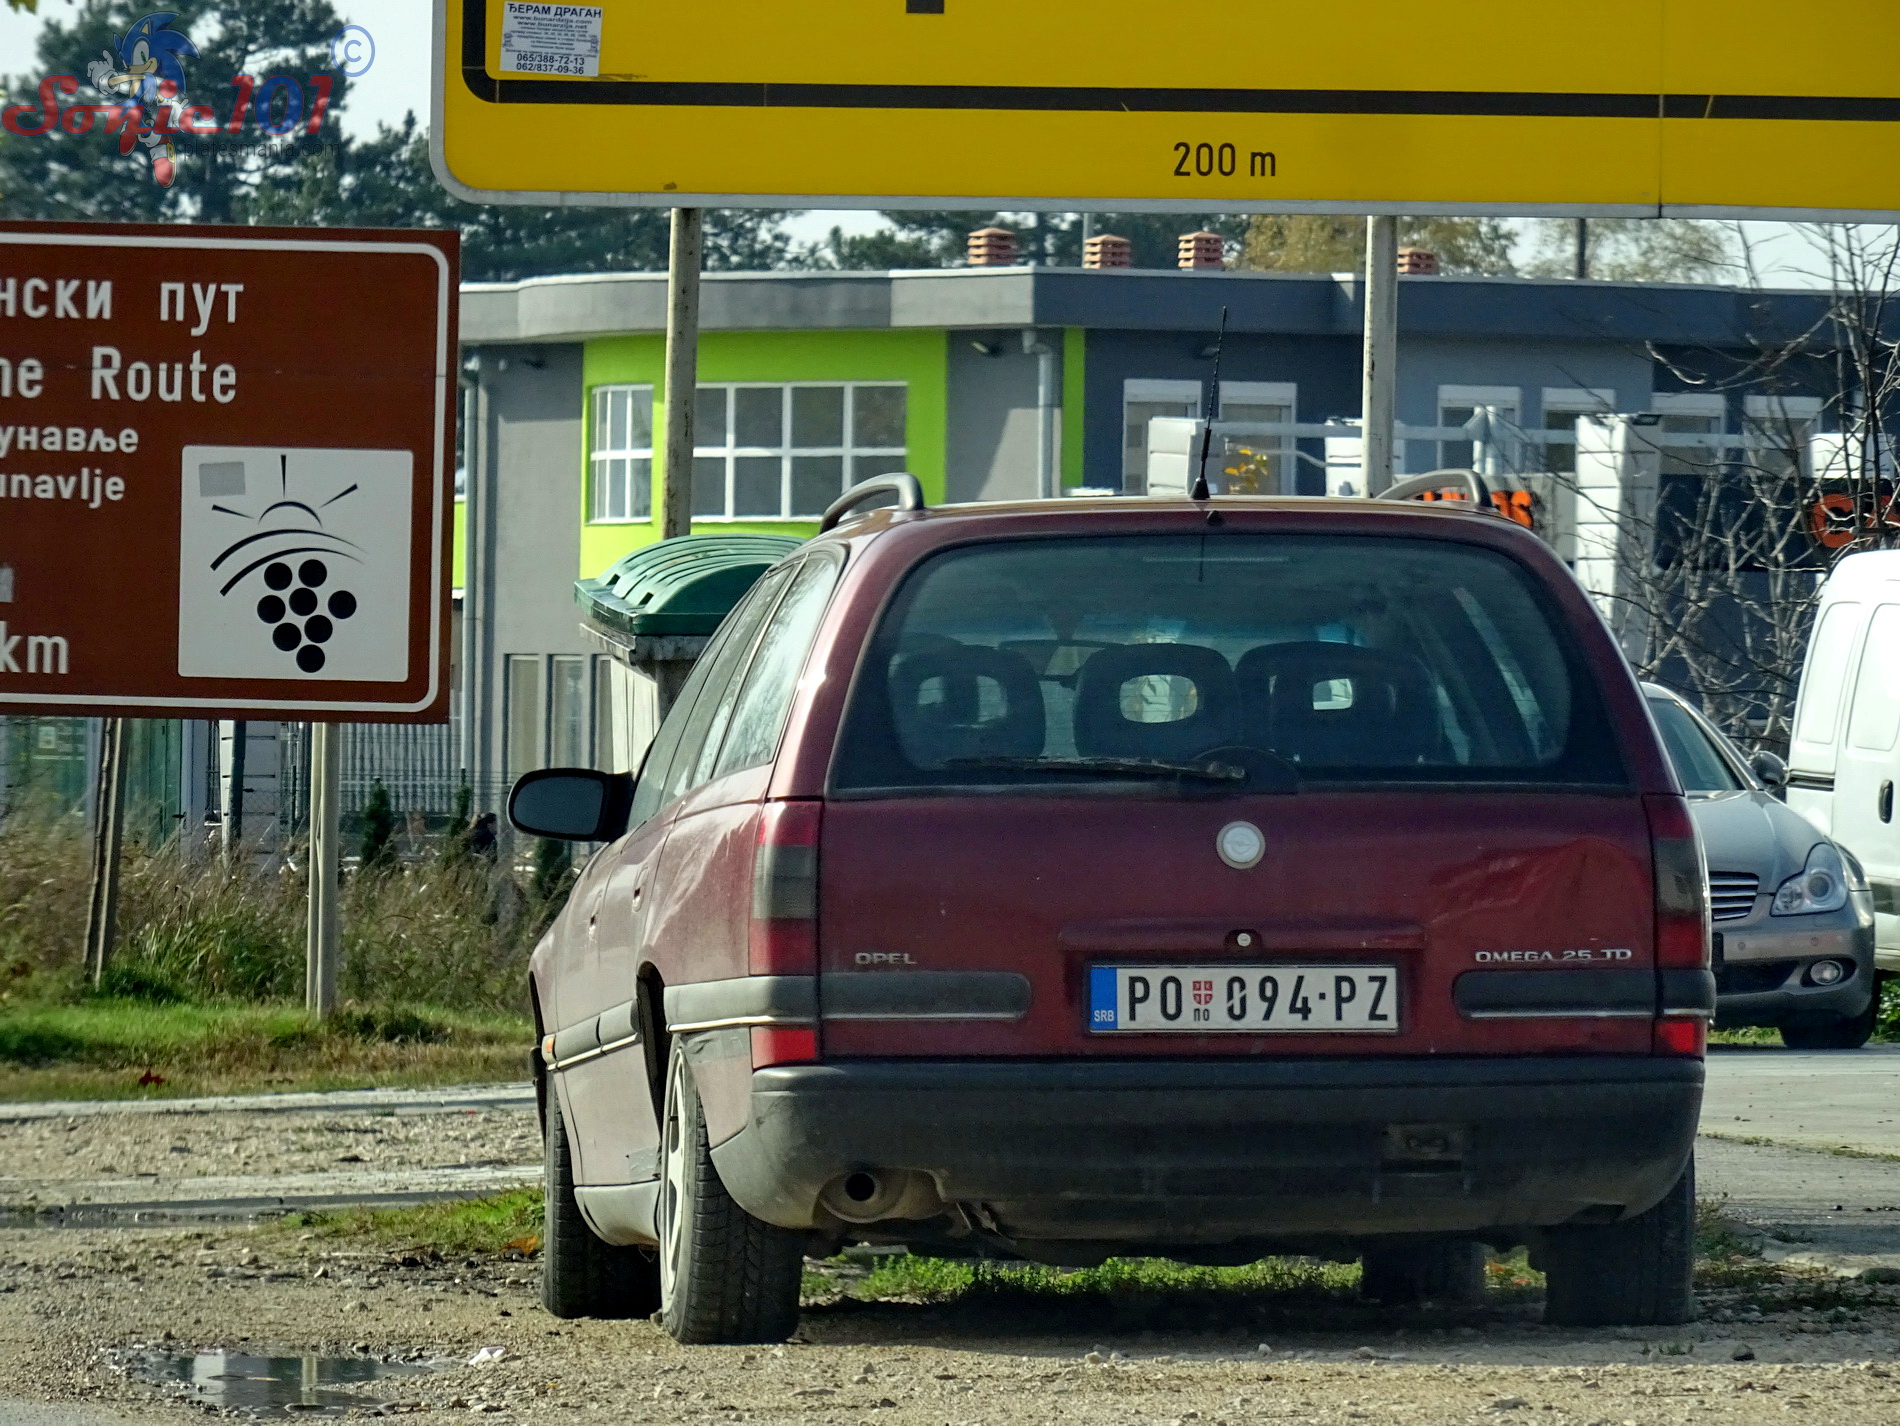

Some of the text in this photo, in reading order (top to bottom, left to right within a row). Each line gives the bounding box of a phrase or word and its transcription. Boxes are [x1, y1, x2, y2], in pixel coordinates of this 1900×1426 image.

[508, 3, 602, 18] ЂЕРАМ ДРАГАН
[517, 53, 585, 66] 065/388-72-13
[516, 62, 584, 75] 062/837-09-36
[1173, 142, 1276, 177] 200 m
[91, 346, 237, 404] Route
[0, 620, 69, 675] km
[855, 952, 918, 965] OPEL
[1475, 950, 1552, 963] OMEGA
[1600, 948, 1633, 961] TD
[1127, 975, 1182, 1022] PO
[1093, 1009, 1114, 1023] SRB
